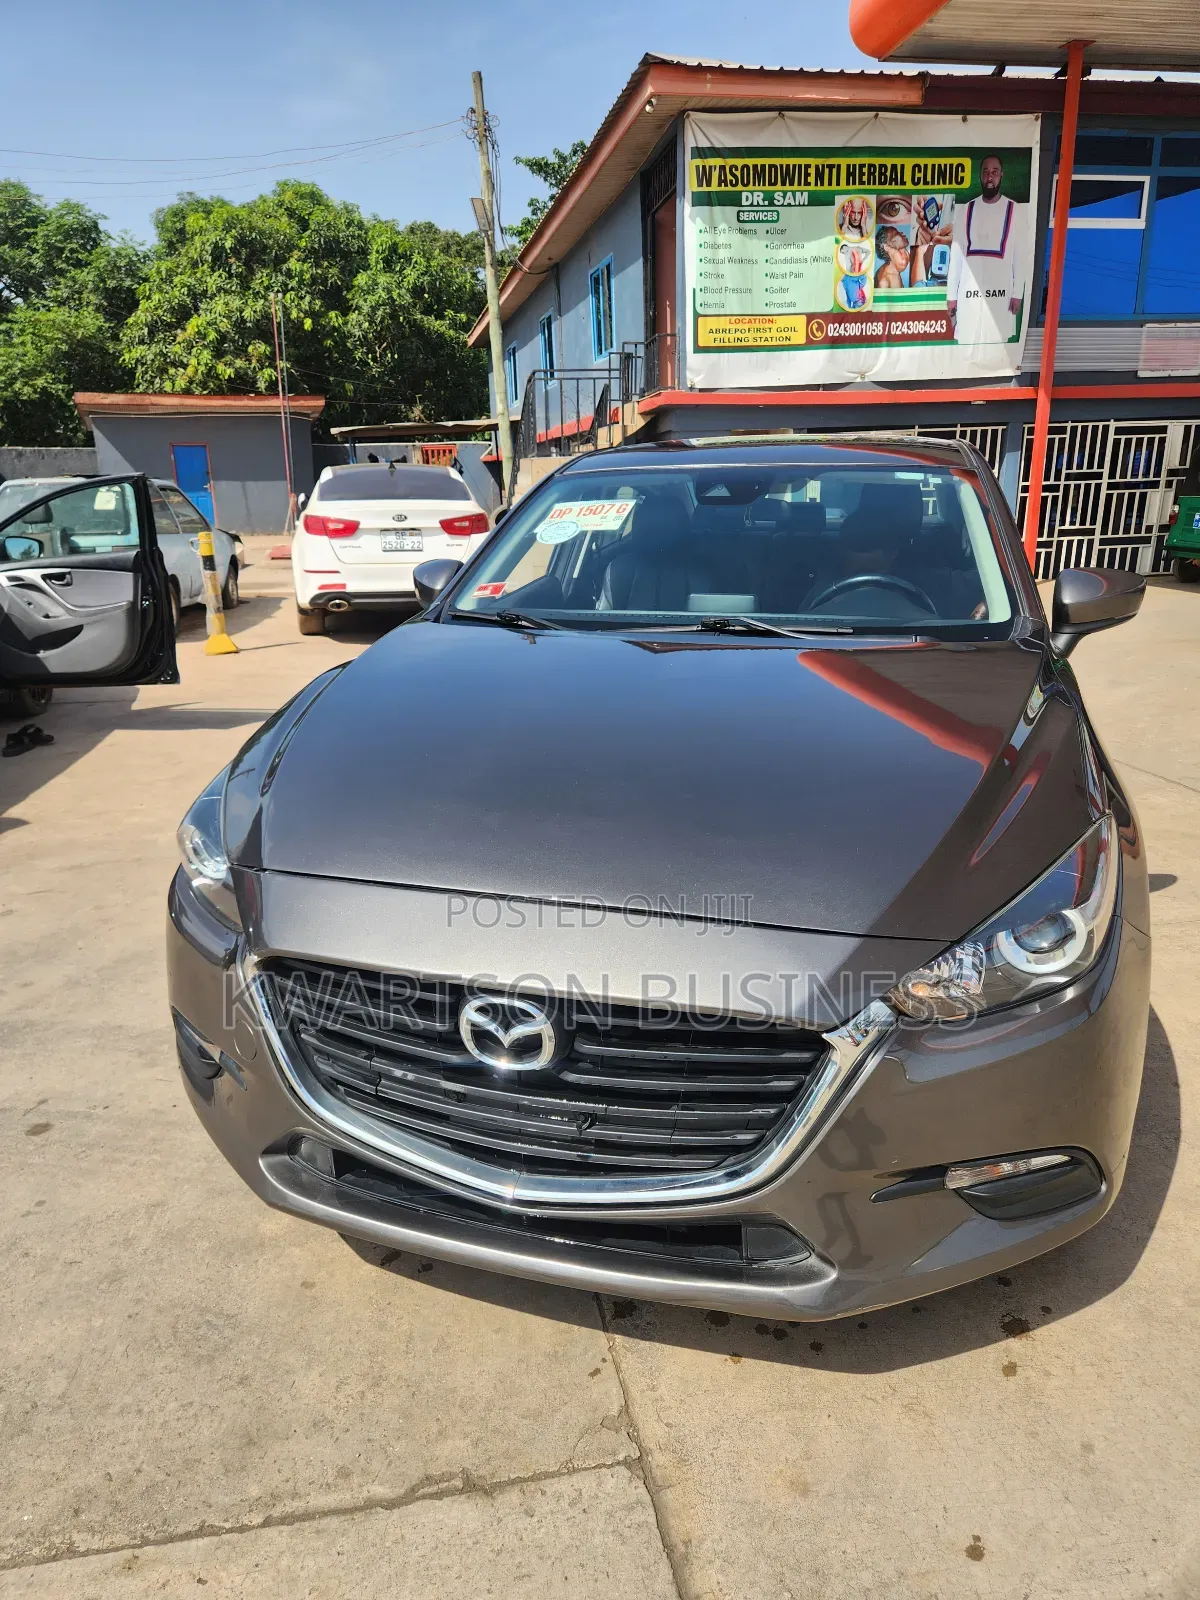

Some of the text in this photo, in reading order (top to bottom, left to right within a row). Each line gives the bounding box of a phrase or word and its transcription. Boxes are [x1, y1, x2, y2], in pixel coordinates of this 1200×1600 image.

[845, 163, 906, 186] HERBAL
[910, 163, 966, 187] CLINIC
[741, 191, 809, 206] DR. SAM
[738, 211, 778, 221] SERVICES
[703, 226, 758, 237] All Eye Problems
[769, 227, 787, 235] Ulcer
[703, 241, 732, 250] Diabetes
[769, 242, 805, 250] Gonorrhea
[703, 256, 759, 265] Sexual Weakness
[769, 255, 834, 266] Candidiasis (White)
[703, 271, 725, 280] Stroke
[769, 271, 804, 280] Waist Pain
[703, 286, 753, 295] Blood Pressure
[769, 286, 790, 294] Goiter
[965, 289, 1006, 299] DR. SAM
[703, 301, 725, 309] Hernia
[769, 300, 797, 309] Prostate
[728, 317, 777, 325] LOCATION:
[827, 321, 883, 337] 0243001058
[890, 319, 947, 335] 0243064243
[713, 335, 791, 344] FILLING STATION
[548, 507, 573, 520] DP
[575, 503, 616, 518] 1507
[615, 503, 629, 514] G
